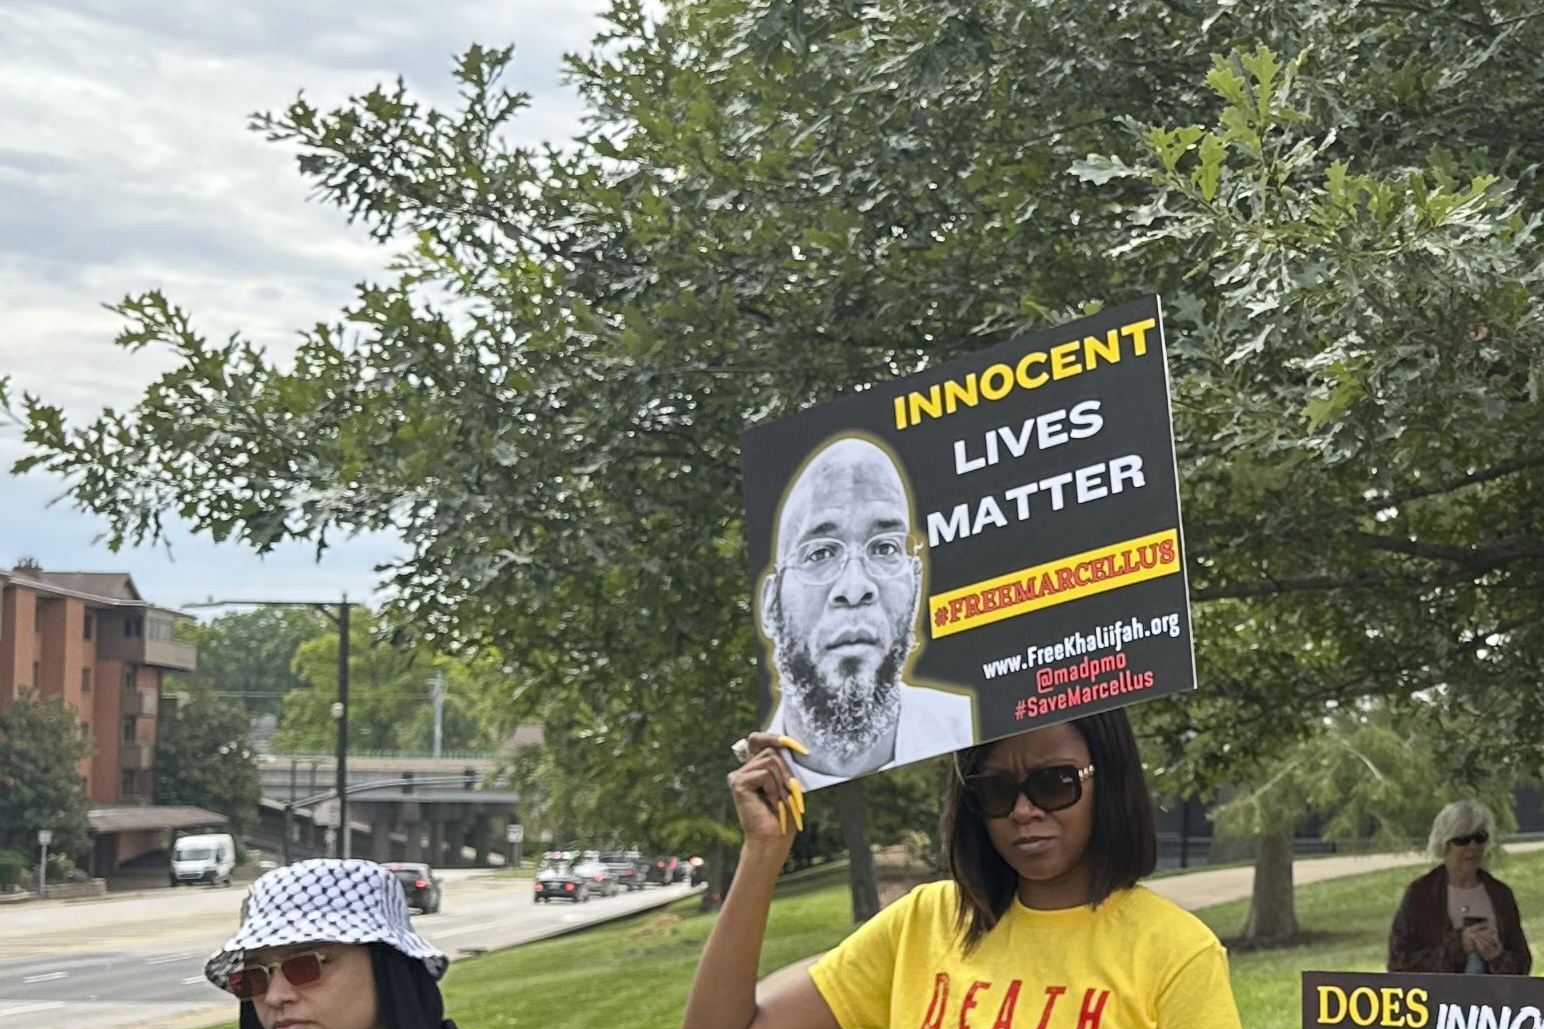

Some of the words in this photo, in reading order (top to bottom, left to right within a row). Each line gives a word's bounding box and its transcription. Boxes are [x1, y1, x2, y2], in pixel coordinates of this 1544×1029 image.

[893, 318, 1156, 430] INNOCENT
[953, 400, 1104, 476] LIVES
[926, 454, 1146, 548] MATTER
[934, 539, 1175, 626] #FREEMARCELLUS
[983, 613, 1180, 680] www.FreeKhaliifah.org
[1036, 652, 1127, 694] @madpmo
[1014, 671, 1154, 721] #SaveMarcellus
[1316, 985, 1429, 1029] DOES
